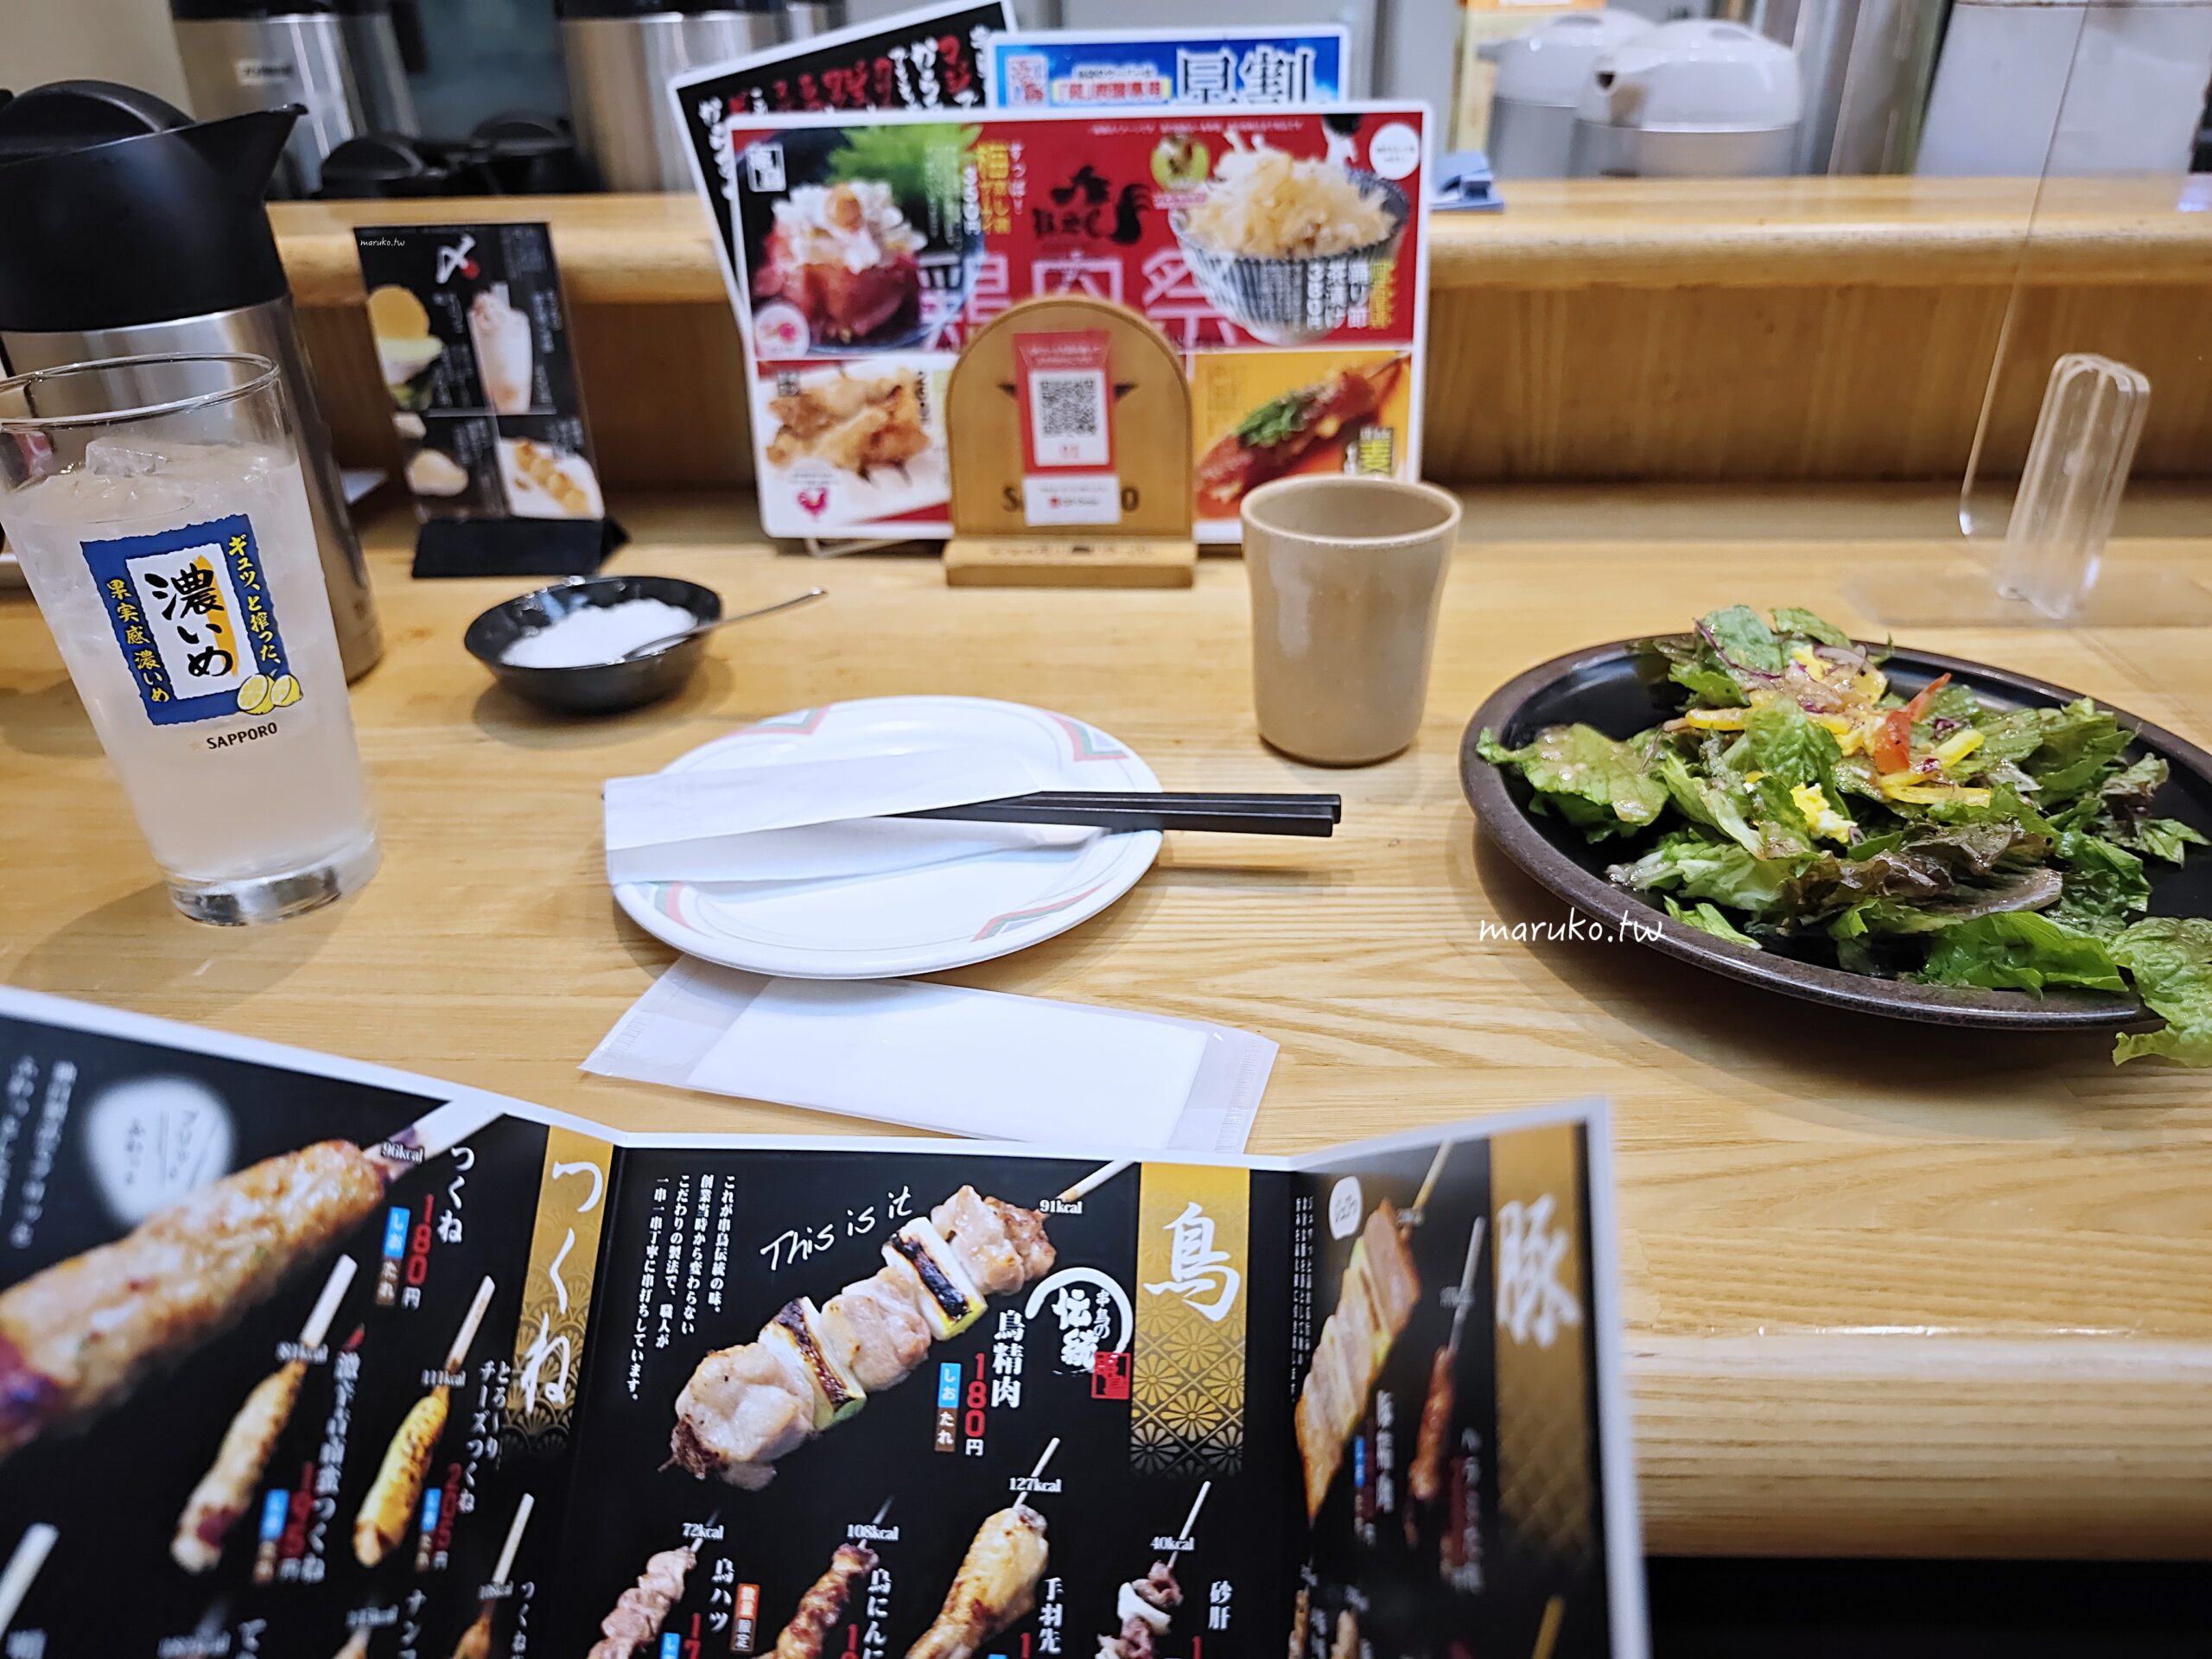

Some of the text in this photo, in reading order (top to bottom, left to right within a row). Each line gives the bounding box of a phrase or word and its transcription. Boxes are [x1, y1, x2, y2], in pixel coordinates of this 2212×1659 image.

[144, 563, 233, 677] 濃いめ
[206, 721, 278, 750] SAPPORO
[436, 1147, 475, 1244] つくね
[760, 1185, 912, 1270] This is it
[1039, 1198, 1083, 1215] 91kcal
[520, 1160, 603, 1414] つくね
[681, 1174, 715, 1335] 創業当時から変わらない
[1143, 1202, 1240, 1322] 鳥
[940, 1367, 957, 1402] しお
[990, 1309, 1026, 1408] 鳥精肉
[937, 1411, 955, 1446] たれ
[964, 1352, 988, 1457] 180円
[1009, 1477, 1062, 1494] 127kcal
[709, 1557, 735, 1633] 鳥ハツ
[1039, 1576, 1065, 1654] 手羽先
[1209, 1580, 1233, 1630] 砂肝
